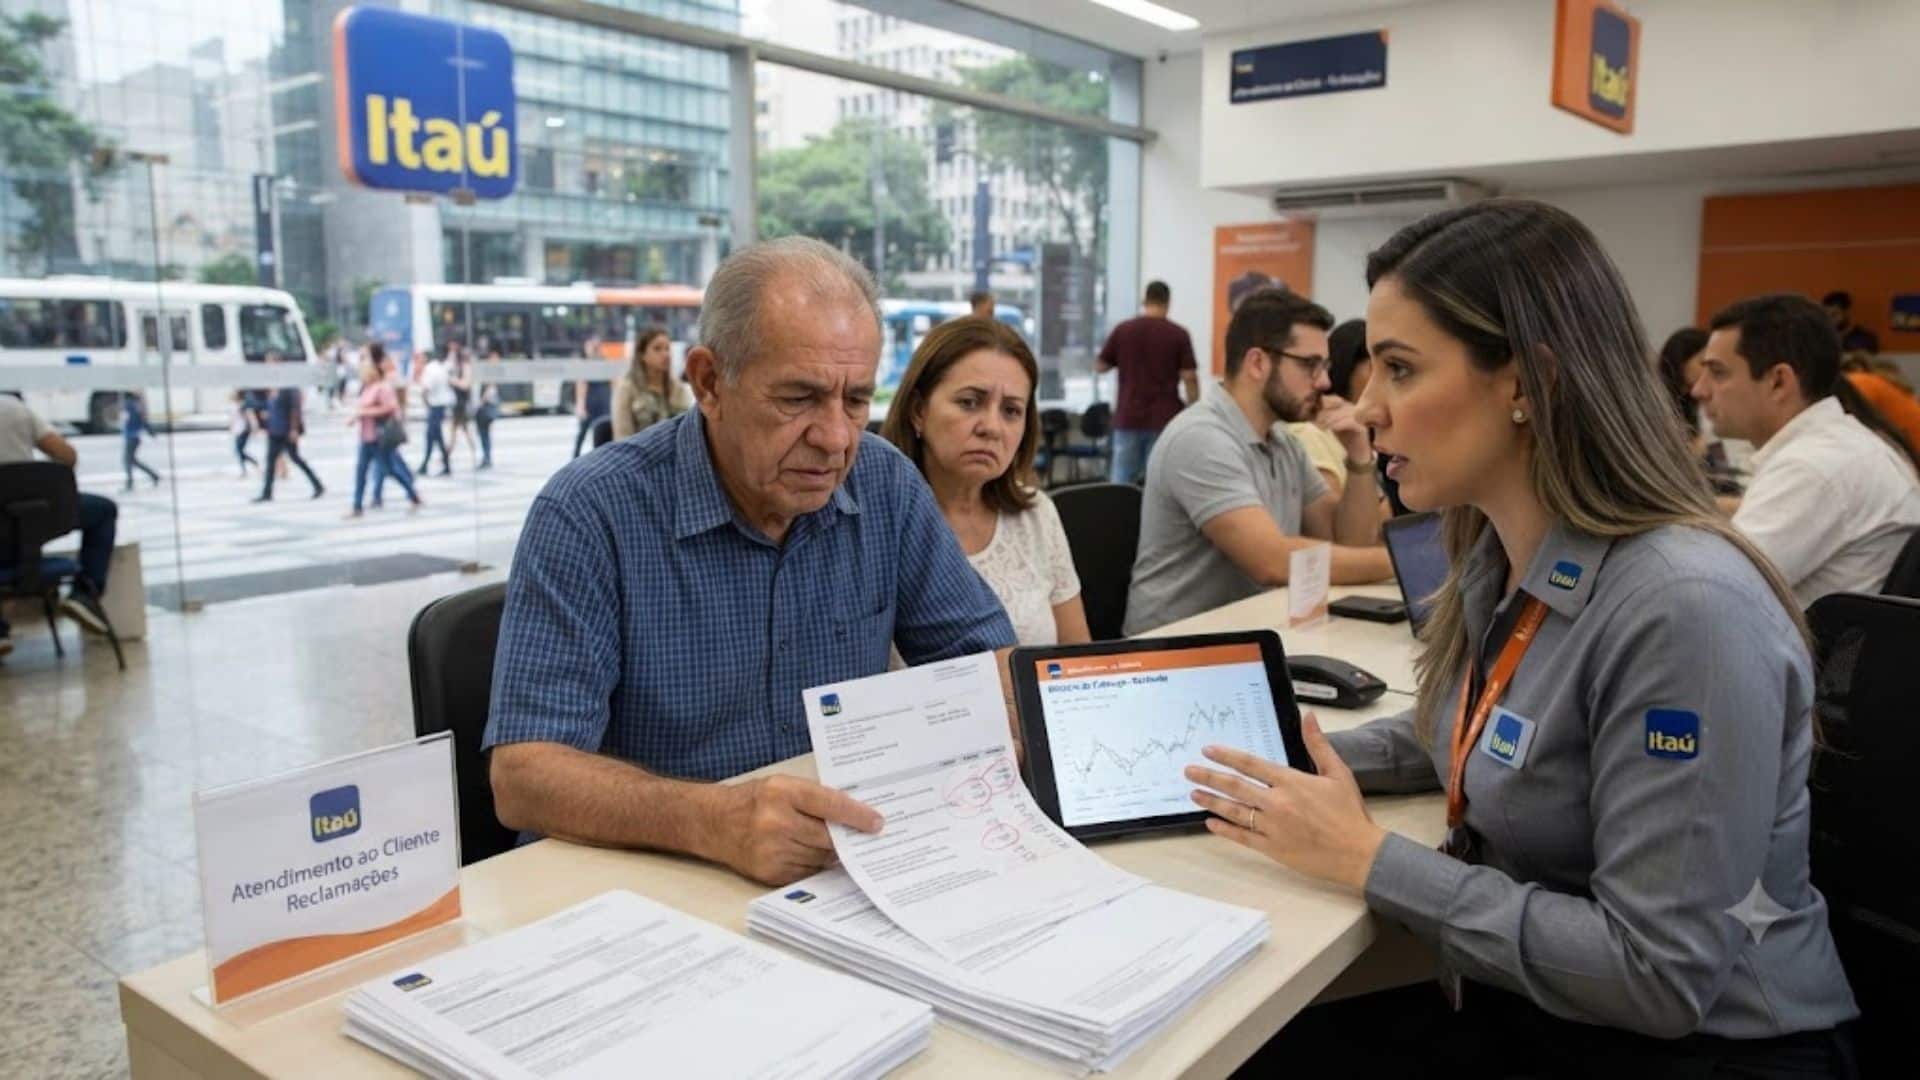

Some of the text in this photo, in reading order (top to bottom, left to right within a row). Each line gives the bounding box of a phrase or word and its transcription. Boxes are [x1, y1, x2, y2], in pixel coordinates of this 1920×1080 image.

[366, 93, 510, 179] Itaú
[231, 828, 440, 903] Atendimento ao Cliente
[286, 865, 399, 913] Reclamações
